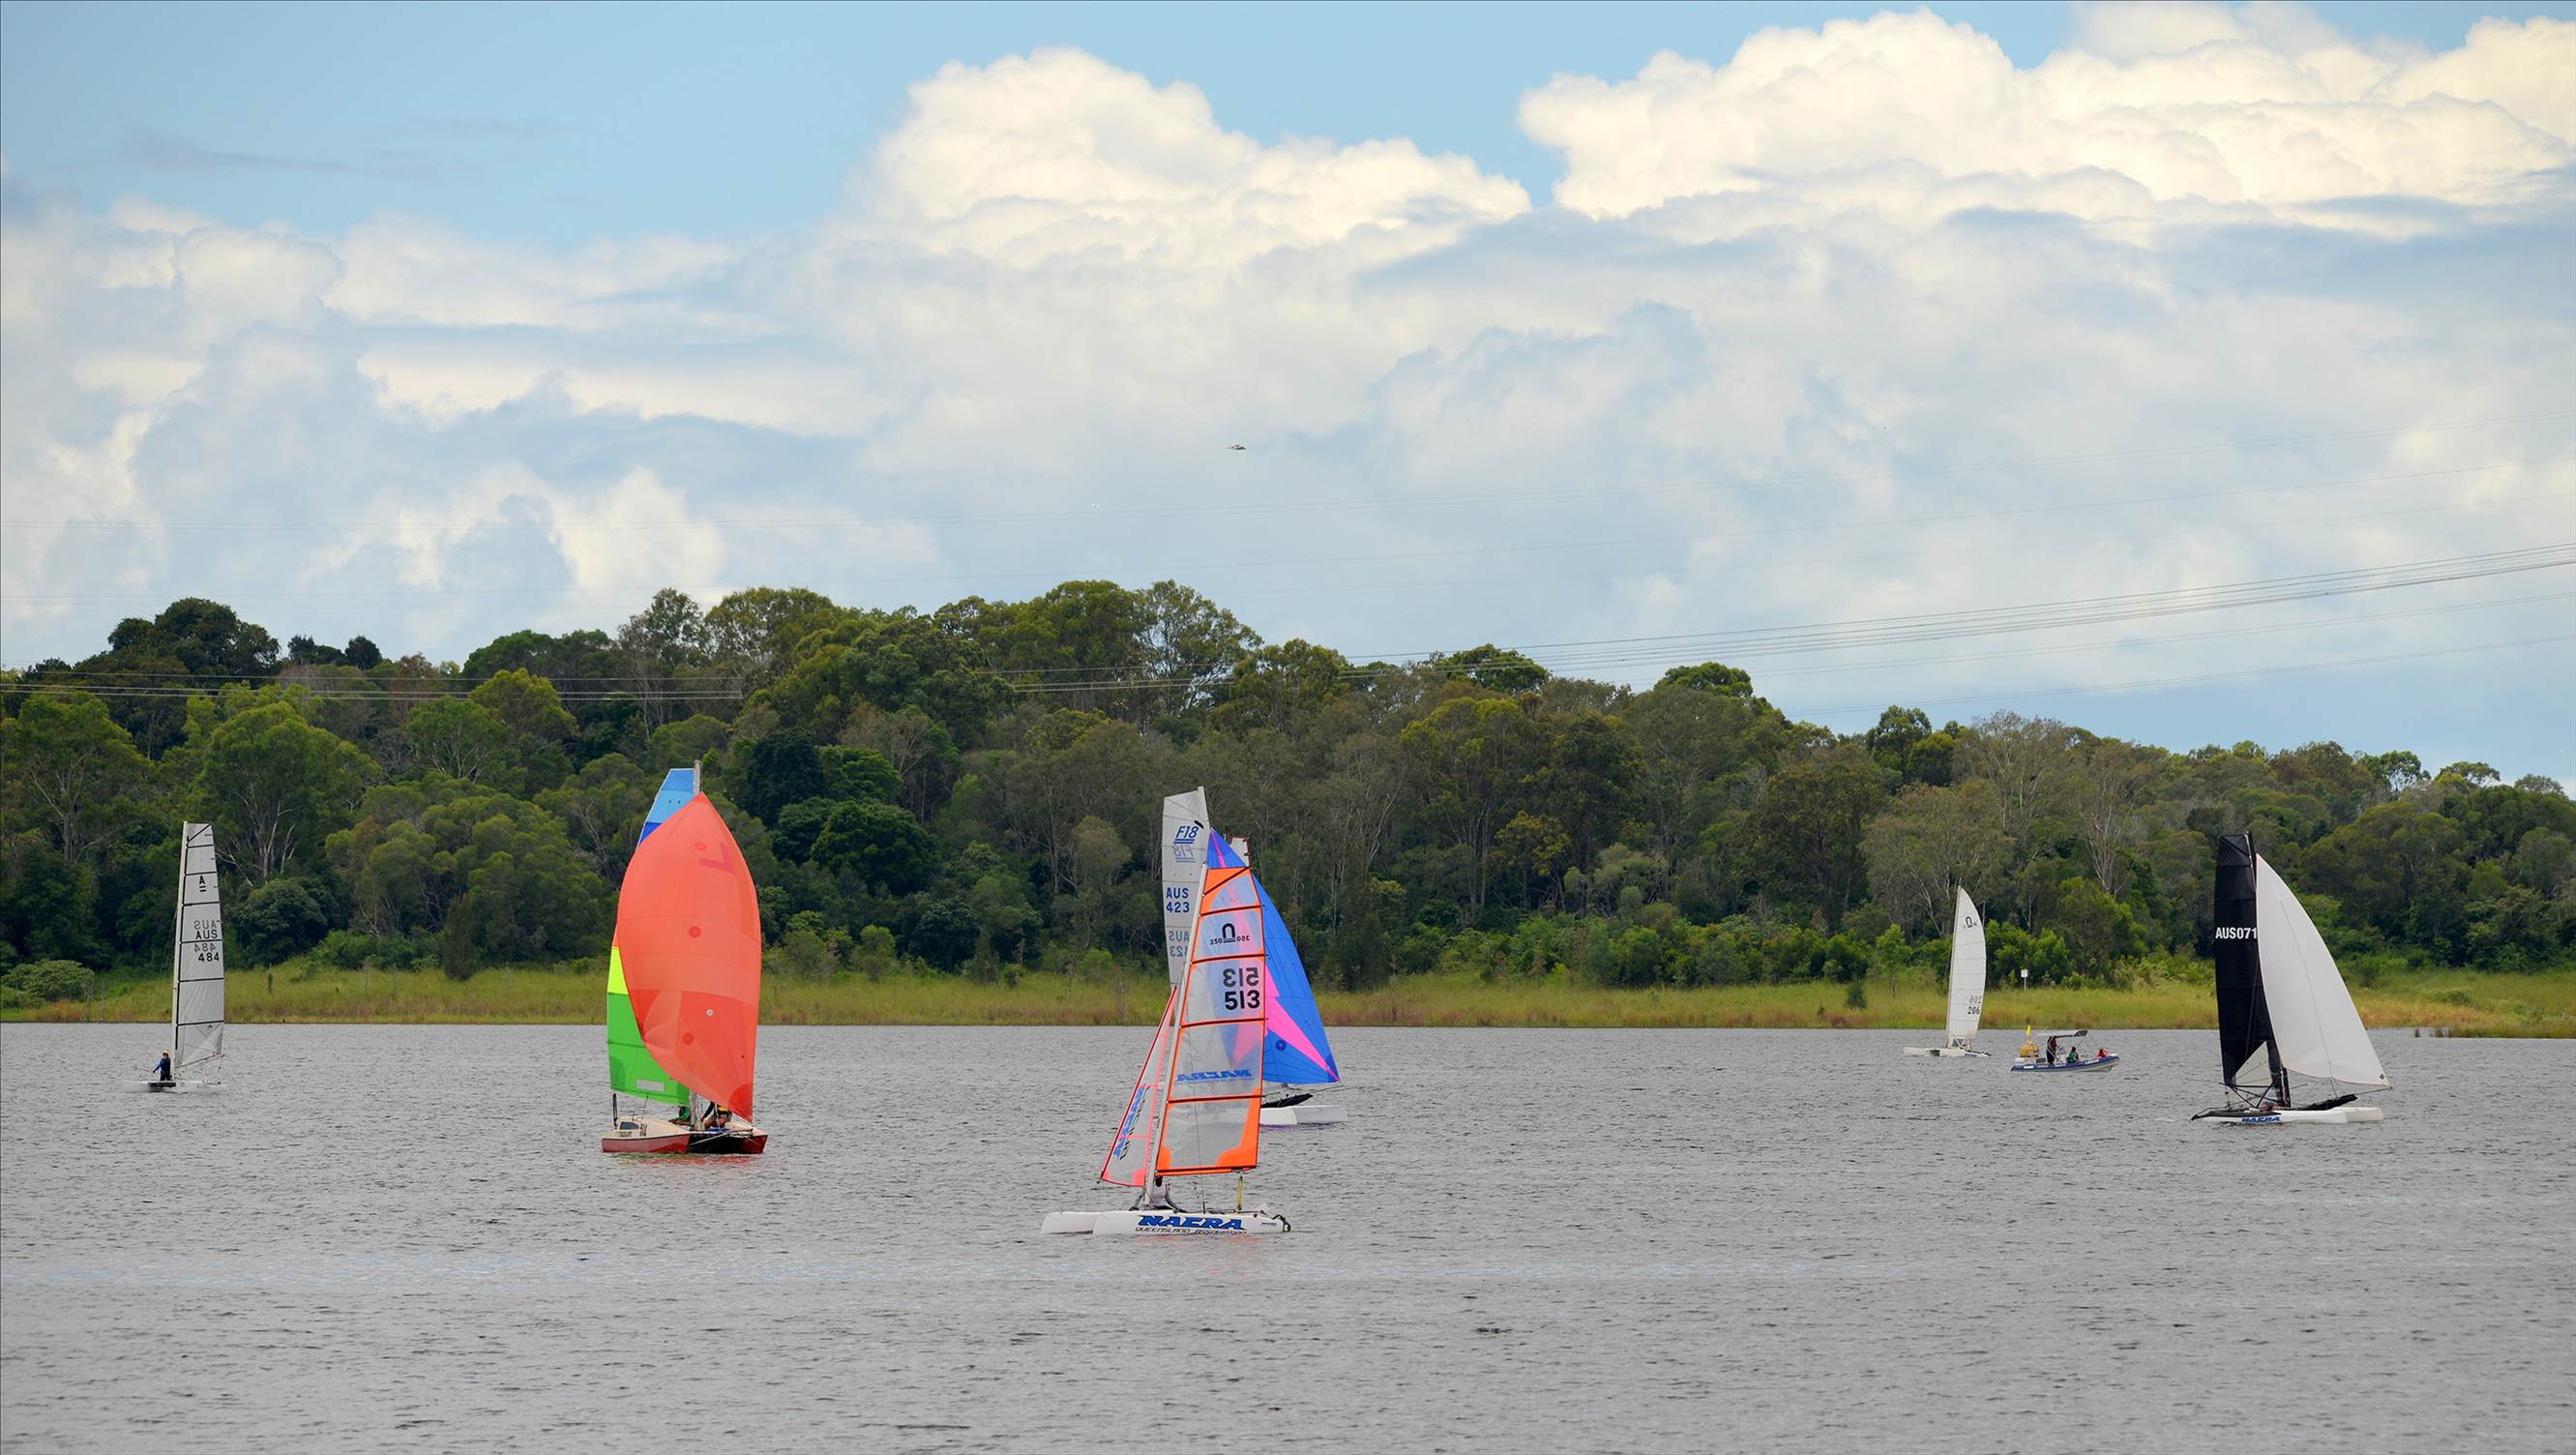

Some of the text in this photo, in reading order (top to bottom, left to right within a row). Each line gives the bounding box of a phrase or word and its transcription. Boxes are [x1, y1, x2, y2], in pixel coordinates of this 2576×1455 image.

[1175, 825, 1200, 839] F18
[198, 875, 206, 885] A
[1166, 887, 1190, 899] AUS
[1166, 901, 1191, 913] 423
[195, 930, 218, 940] AUS
[2215, 927, 2257, 939] AUS071
[198, 952, 220, 963] 484
[1224, 990, 1260, 1011] 513
[1138, 1215, 1246, 1230] NACRA
